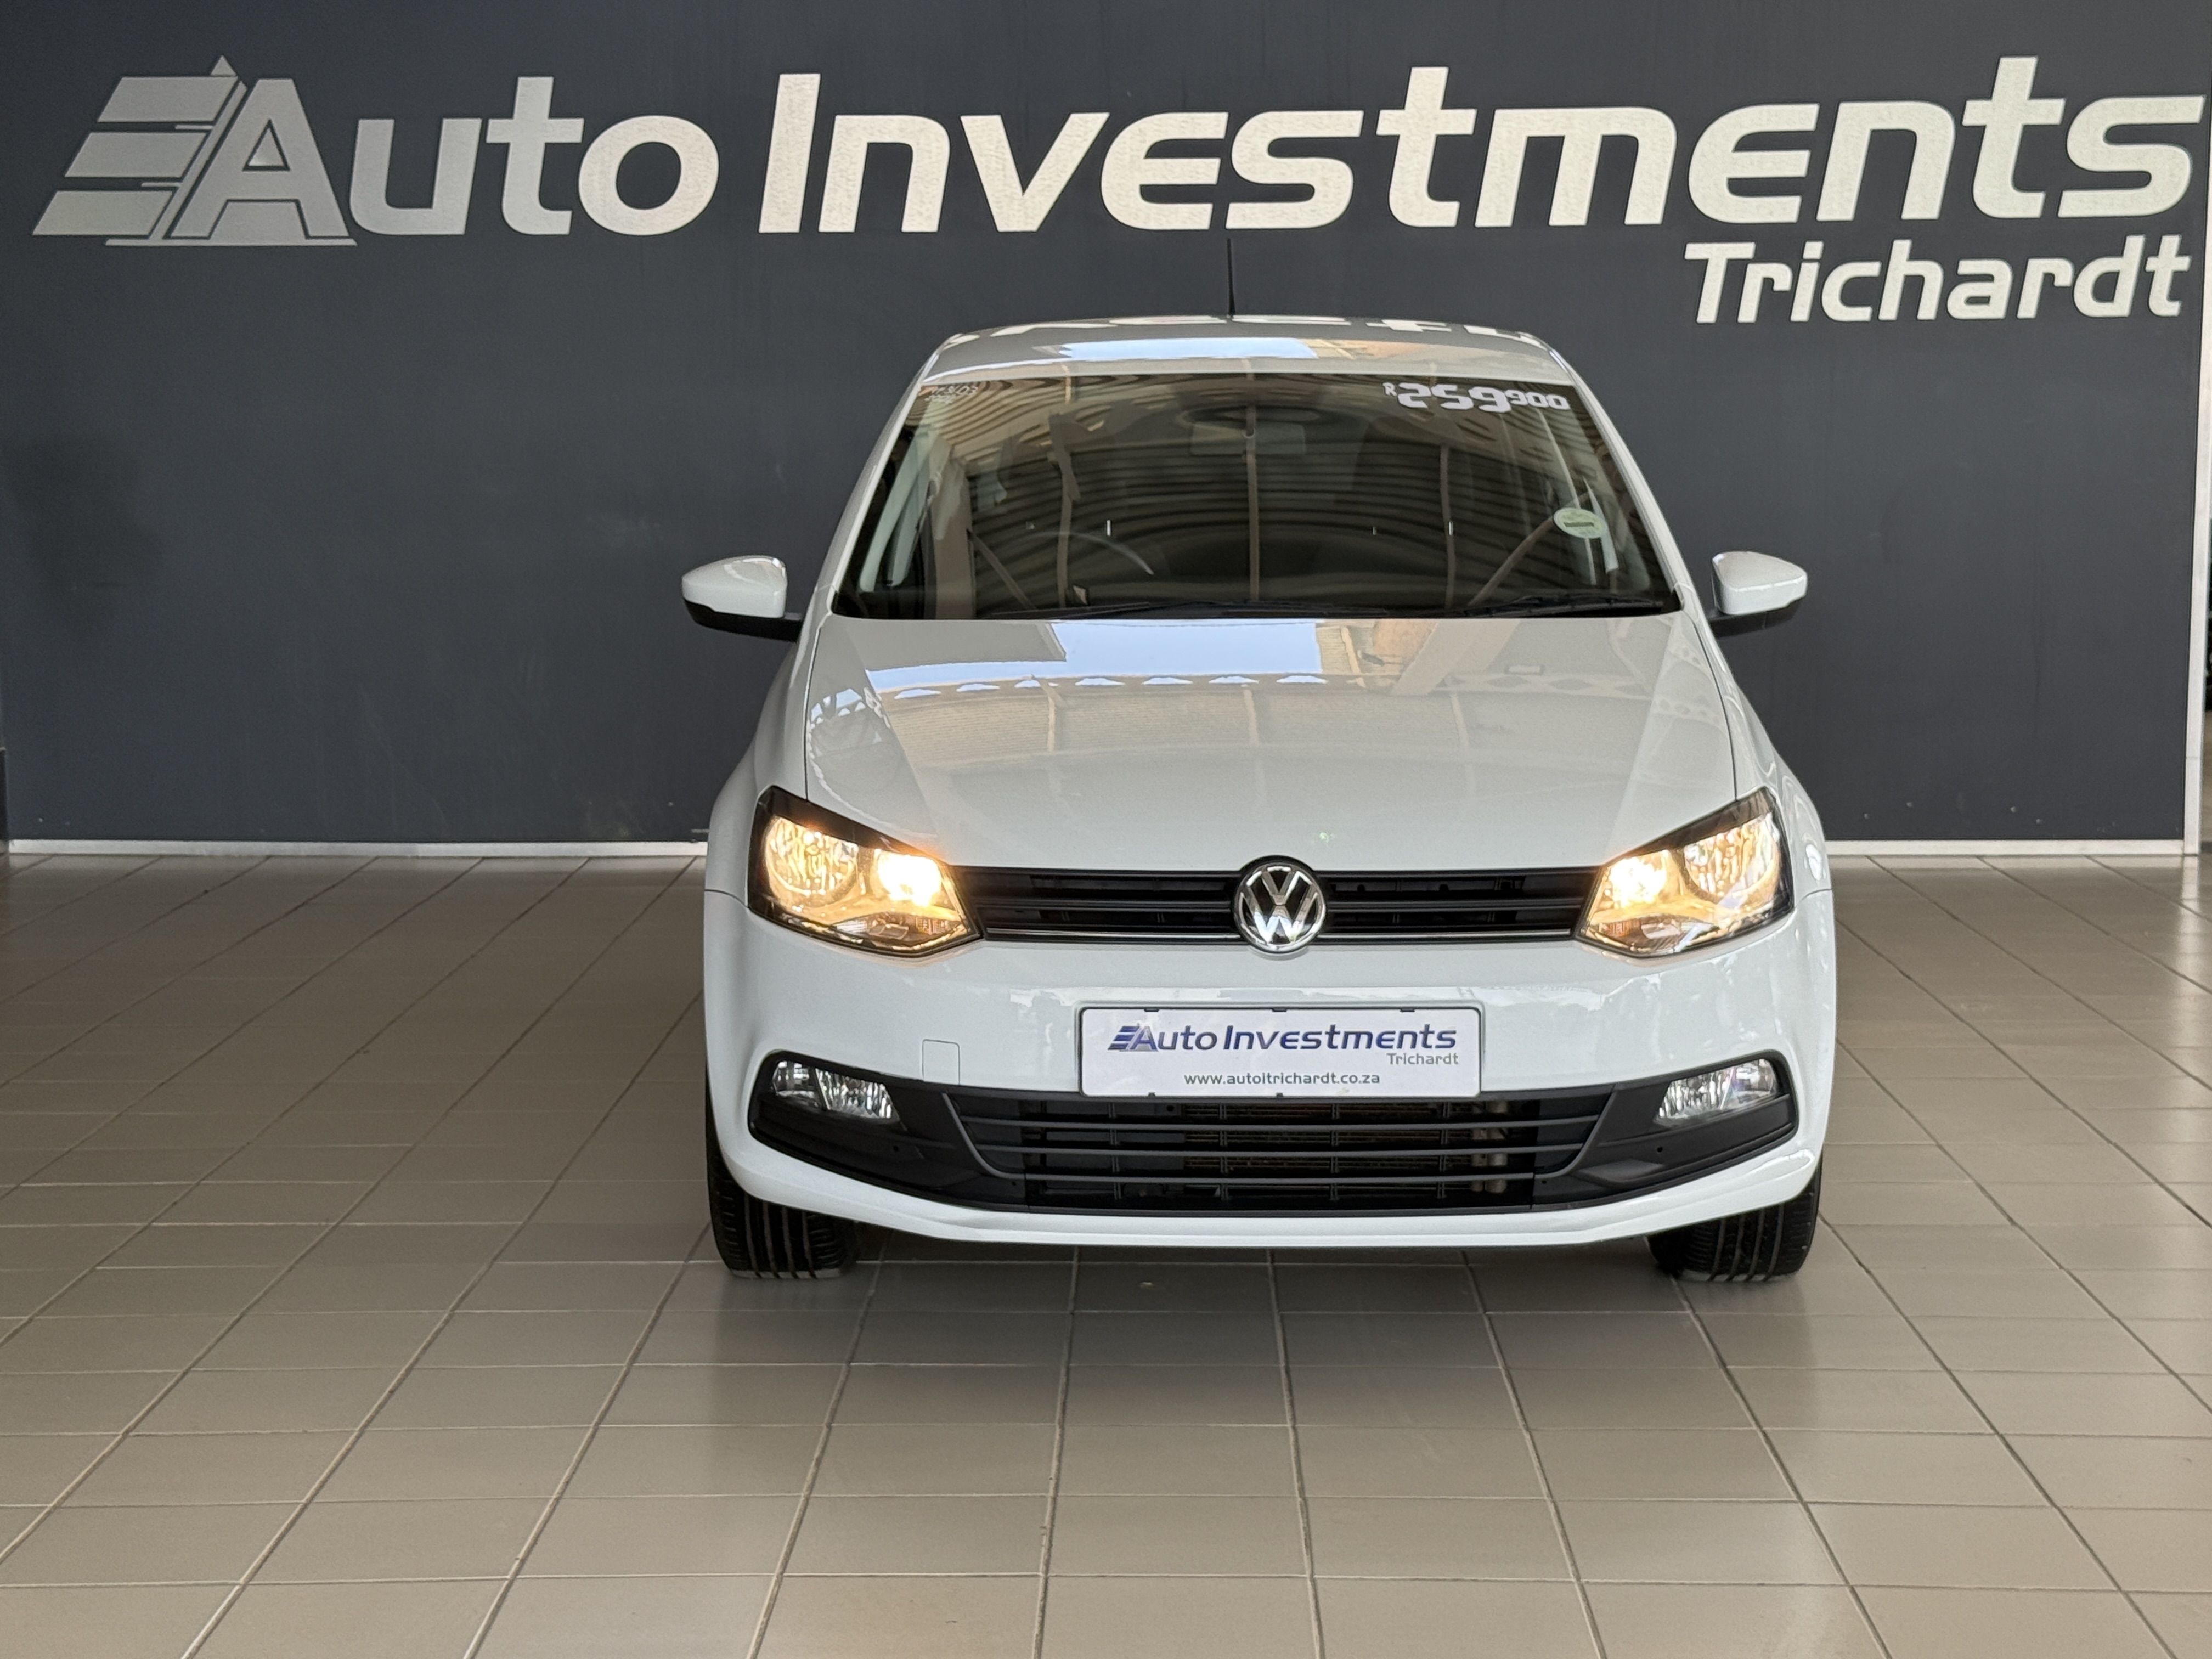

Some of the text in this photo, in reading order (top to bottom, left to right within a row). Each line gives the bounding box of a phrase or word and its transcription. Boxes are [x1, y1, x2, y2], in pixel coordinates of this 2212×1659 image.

[169, 55, 2205, 237] Auto Investments
[1684, 234, 2191, 324] Trichardt
[1130, 1023, 1457, 1051] Auto Investments
[1386, 1052, 1459, 1065] Trichardt
[1184, 1072, 1380, 1084] www.autoitrichardt.co.za
